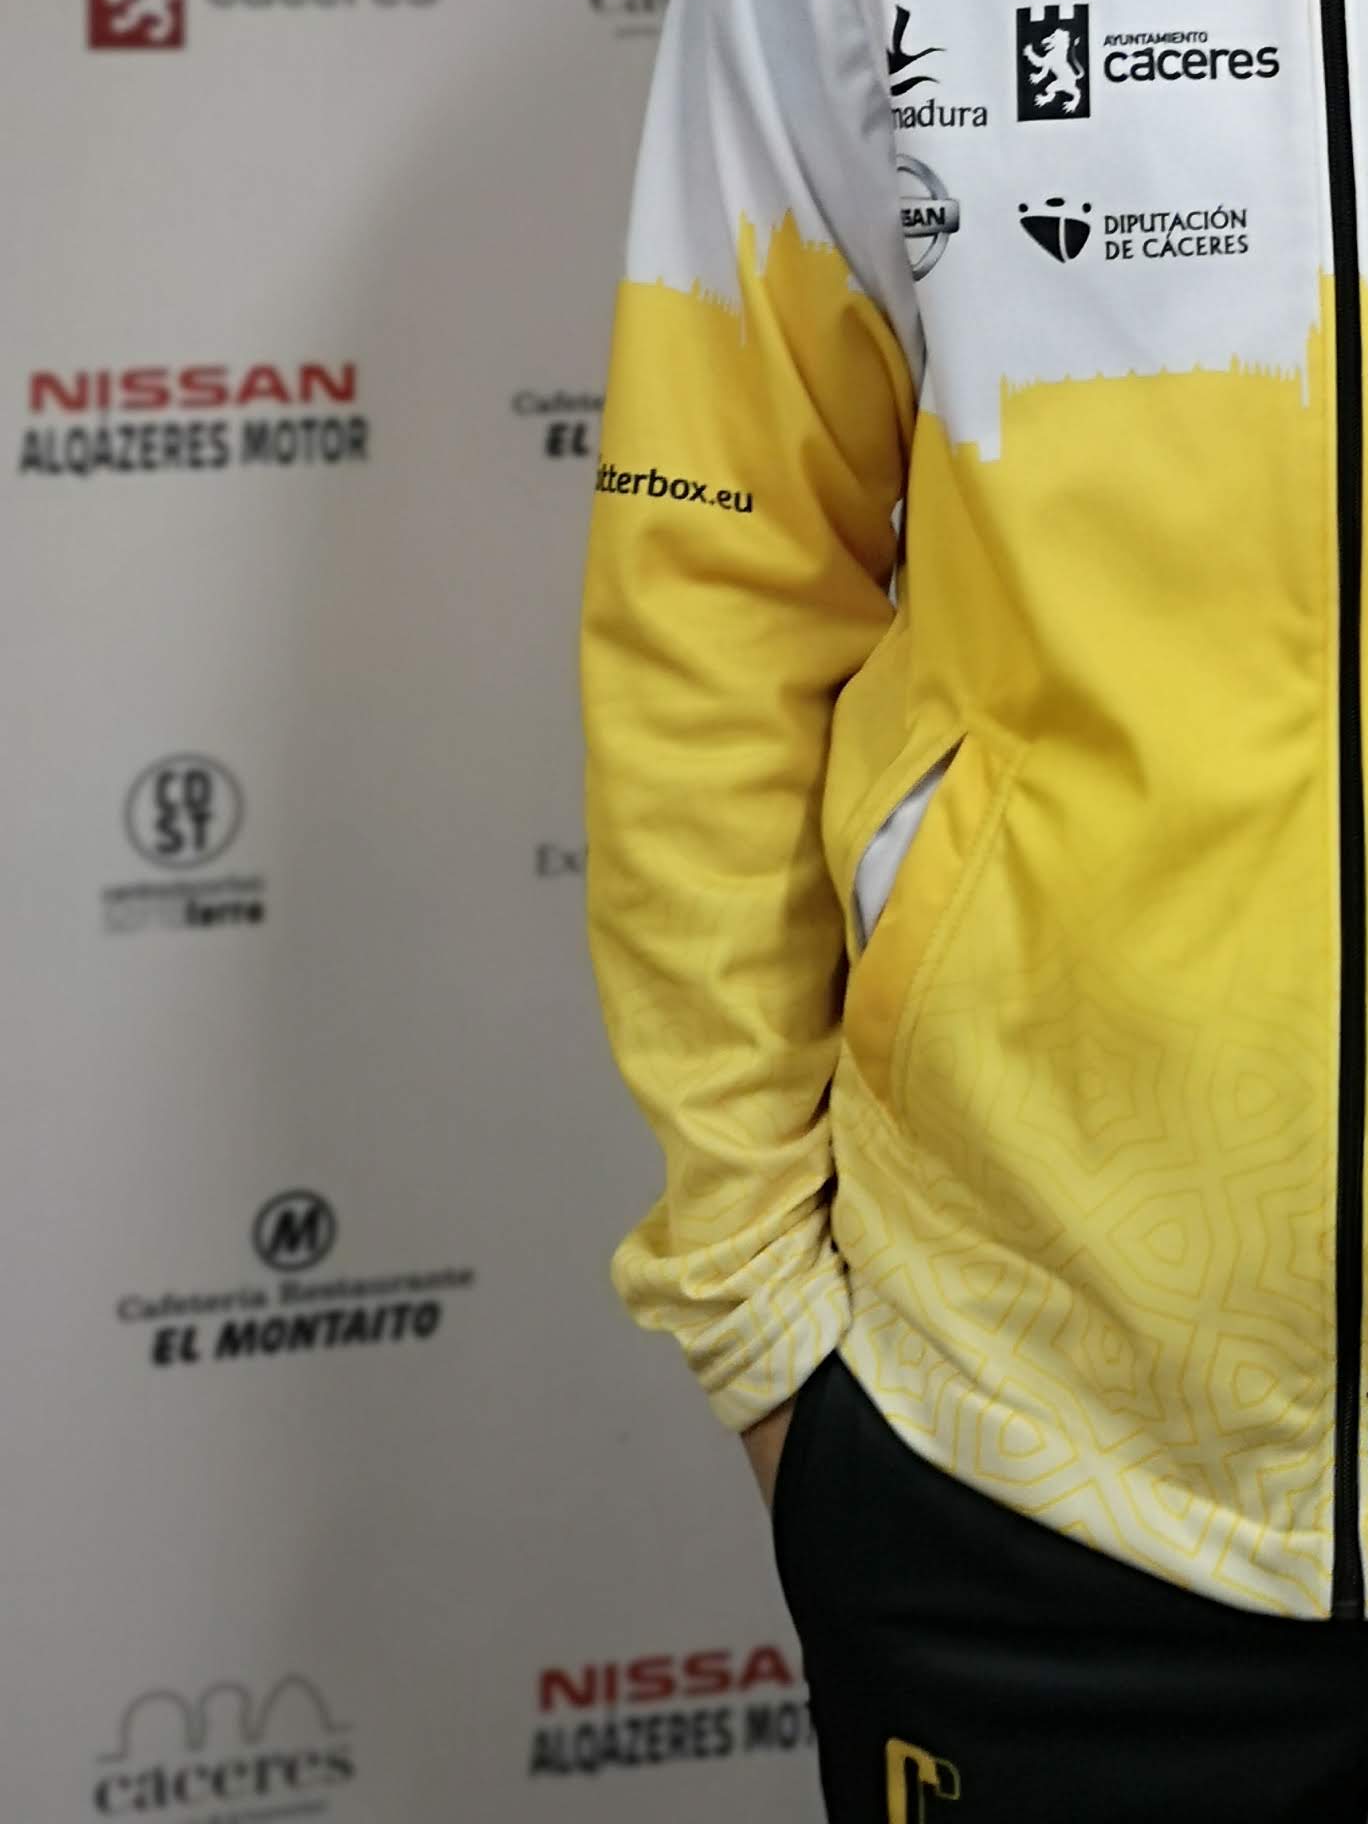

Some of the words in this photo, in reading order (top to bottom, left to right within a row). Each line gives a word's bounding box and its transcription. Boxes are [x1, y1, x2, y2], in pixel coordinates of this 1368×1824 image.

[1103, 31, 1209, 47] AYUNTAMIENTO
[1104, 205, 1248, 235] DIPUTACIÓN
[1104, 244, 1134, 261] DE
[1141, 230, 1249, 259] CÁCERES
[28, 360, 357, 416] NISSAN
[239, 416, 367, 466] MOTOR
[152, 1326, 200, 1367] EL
